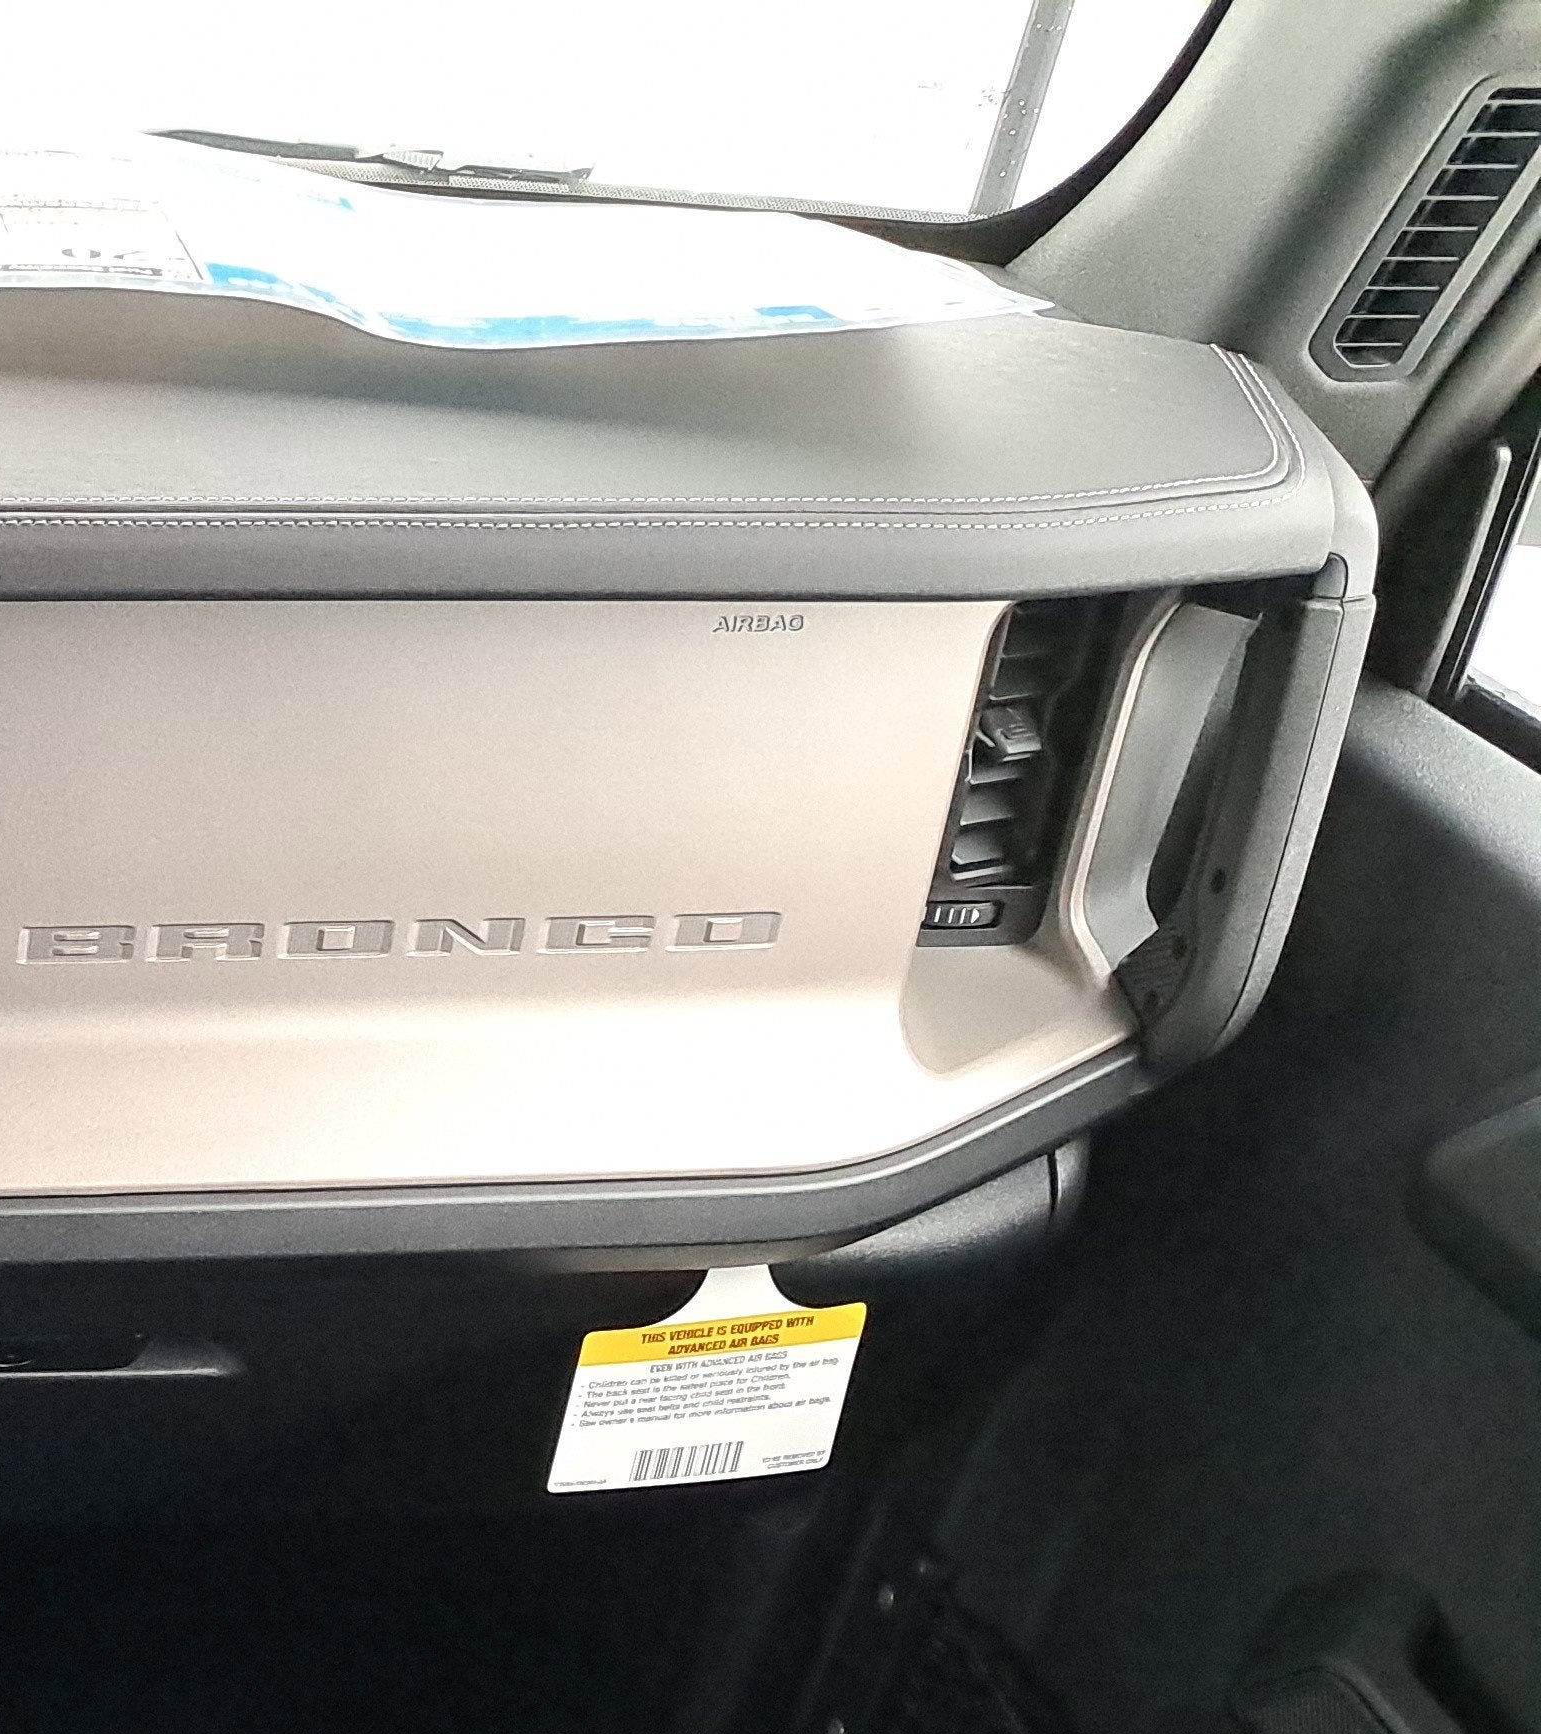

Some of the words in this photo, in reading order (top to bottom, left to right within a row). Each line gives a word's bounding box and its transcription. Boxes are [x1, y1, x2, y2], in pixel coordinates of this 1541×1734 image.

[712, 614, 804, 633] AIRBAG
[17, 911, 783, 965] BRONCO
[641, 1332, 666, 1344] THIS
[669, 1327, 714, 1341] VEHICLE
[717, 1326, 727, 1336] IS
[730, 1319, 783, 1334] EQUIPPED
[787, 1316, 815, 1328] WITH
[667, 1340, 726, 1355] ADVANCED
[729, 1338, 748, 1349] AIR
[750, 1334, 780, 1346] BAGS
